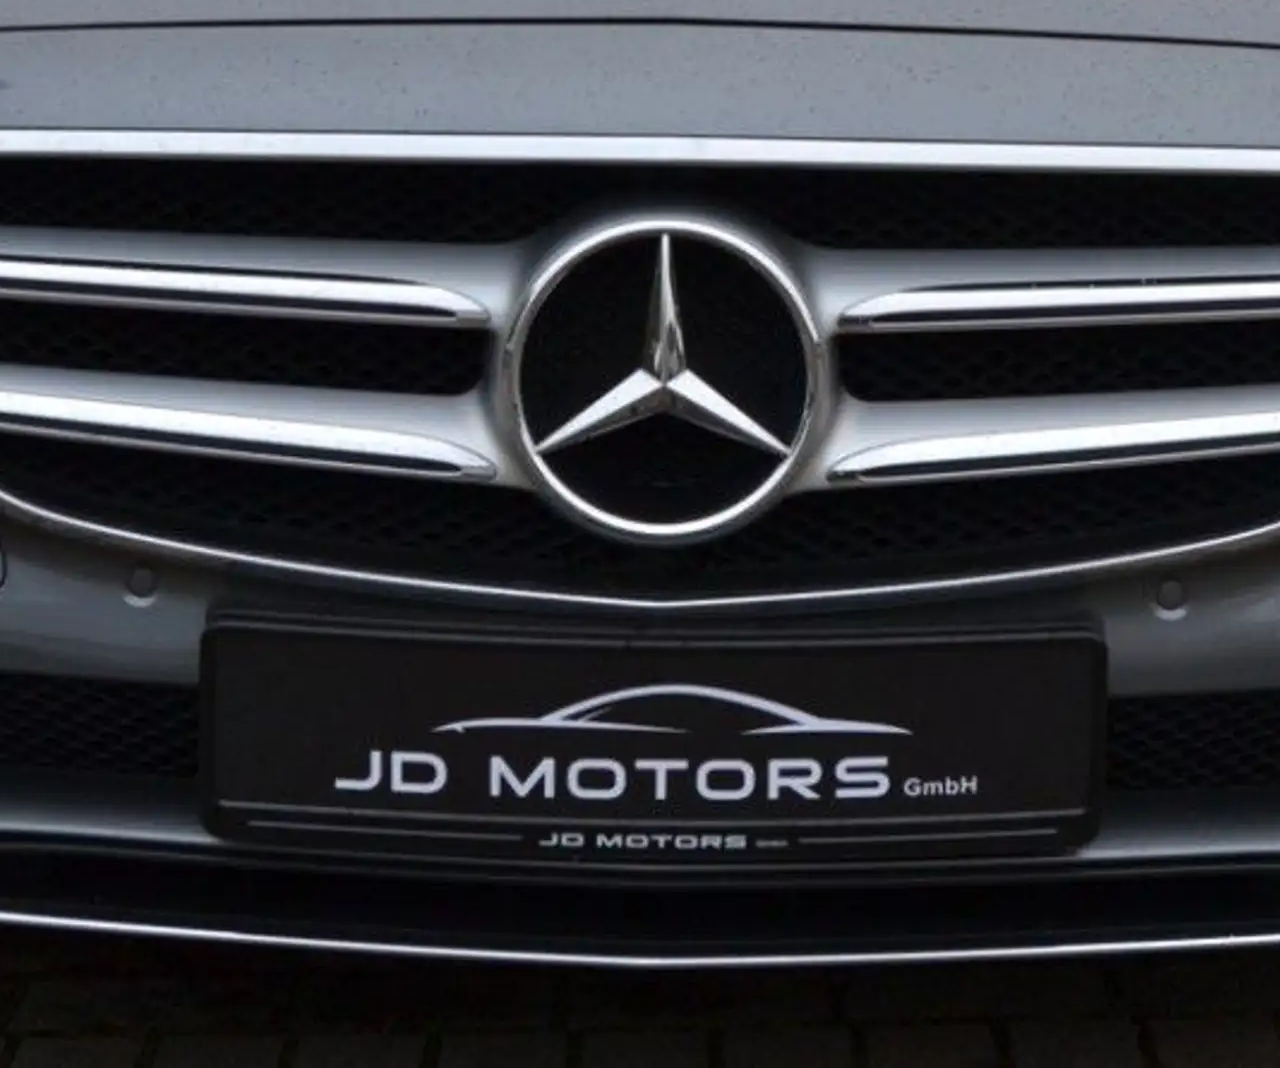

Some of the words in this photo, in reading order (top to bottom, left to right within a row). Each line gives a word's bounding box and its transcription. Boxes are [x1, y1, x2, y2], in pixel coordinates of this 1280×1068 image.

[335, 750, 448, 794] JD
[490, 756, 890, 800] MOTORS
[903, 775, 978, 797] GmbH
[539, 833, 584, 847] JD
[596, 833, 747, 850] MOTORS
